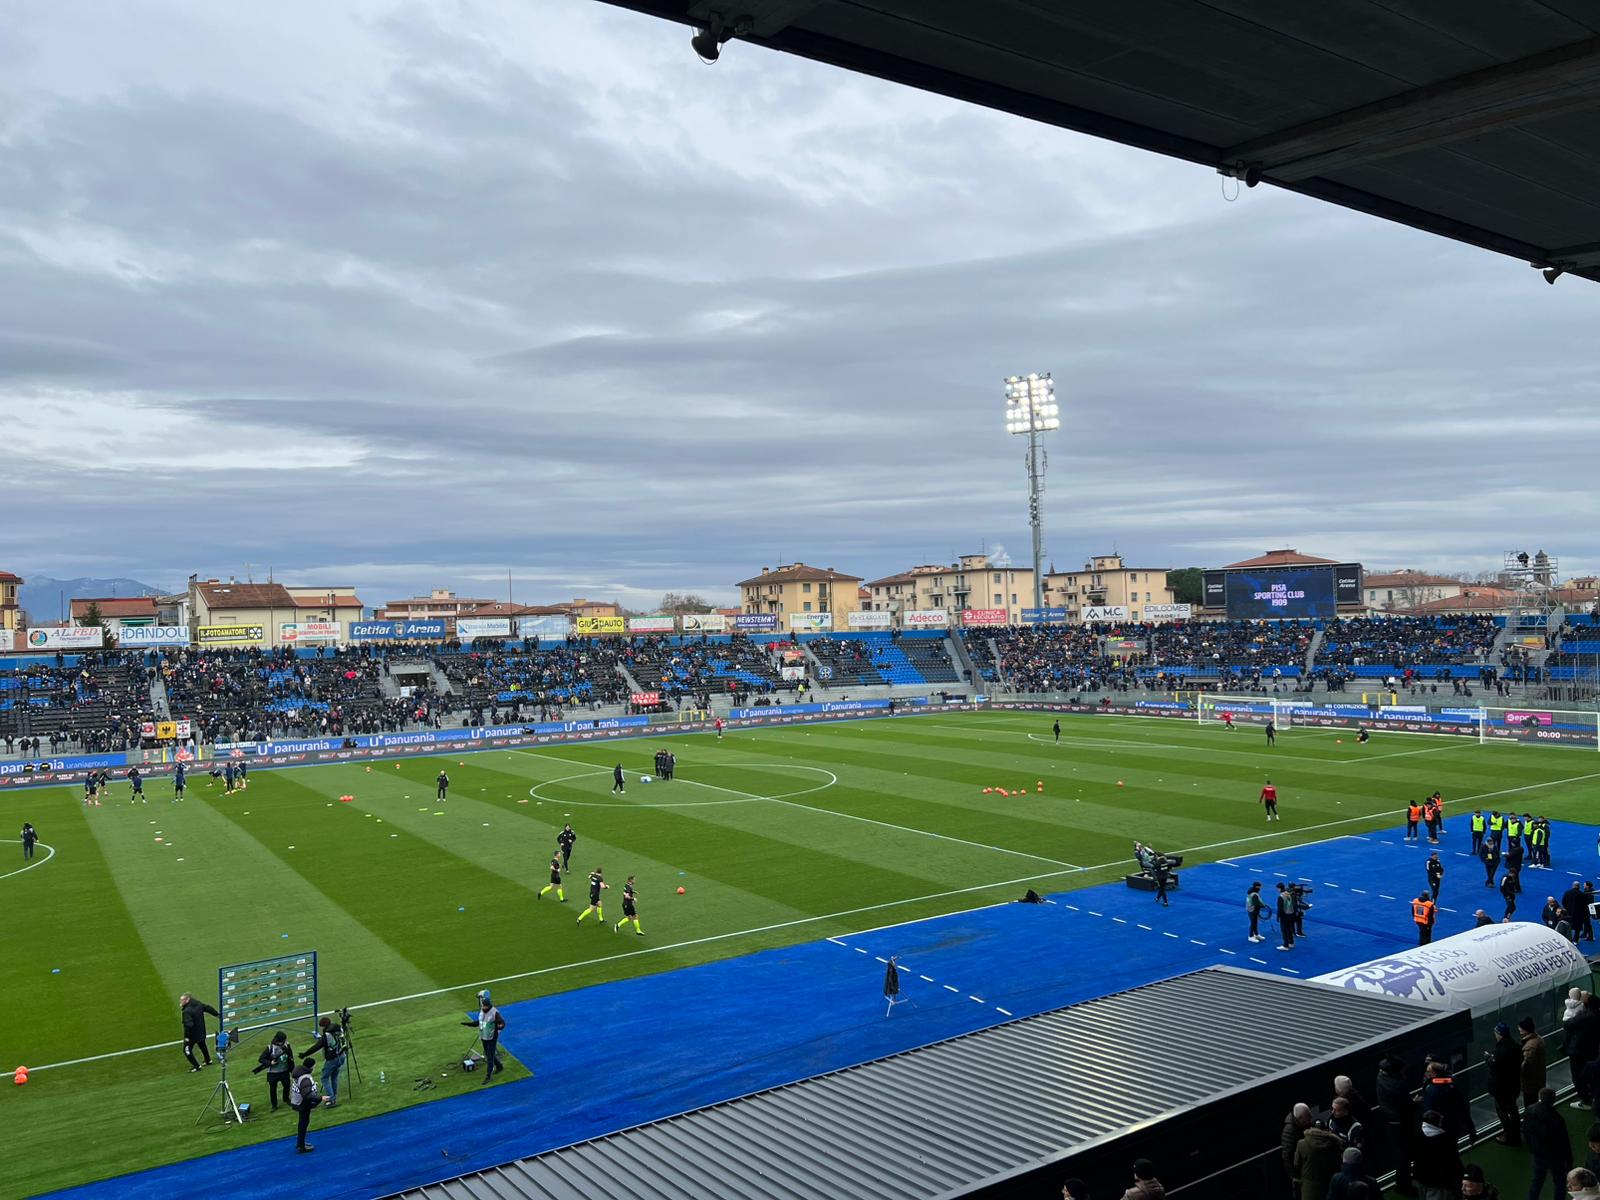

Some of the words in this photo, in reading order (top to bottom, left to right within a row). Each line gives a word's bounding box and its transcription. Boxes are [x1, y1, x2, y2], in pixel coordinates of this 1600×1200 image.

[126, 628, 188, 639] DANDOLI
[206, 629, 246, 637] FOTOAMATORE
[354, 626, 391, 635] Cetilar
[407, 625, 440, 633] Arena
[831, 702, 861, 710] panurania
[750, 707, 782, 717] panurania
[385, 733, 435, 745] panurania
[275, 740, 329, 753] panurania
[1537, 938, 1565, 954] EDILE
[1439, 961, 1480, 982] service
[1498, 974, 1514, 988] SU
[1512, 960, 1550, 983] MISURA
[1547, 955, 1566, 970] PER
[1562, 950, 1577, 963] TE
